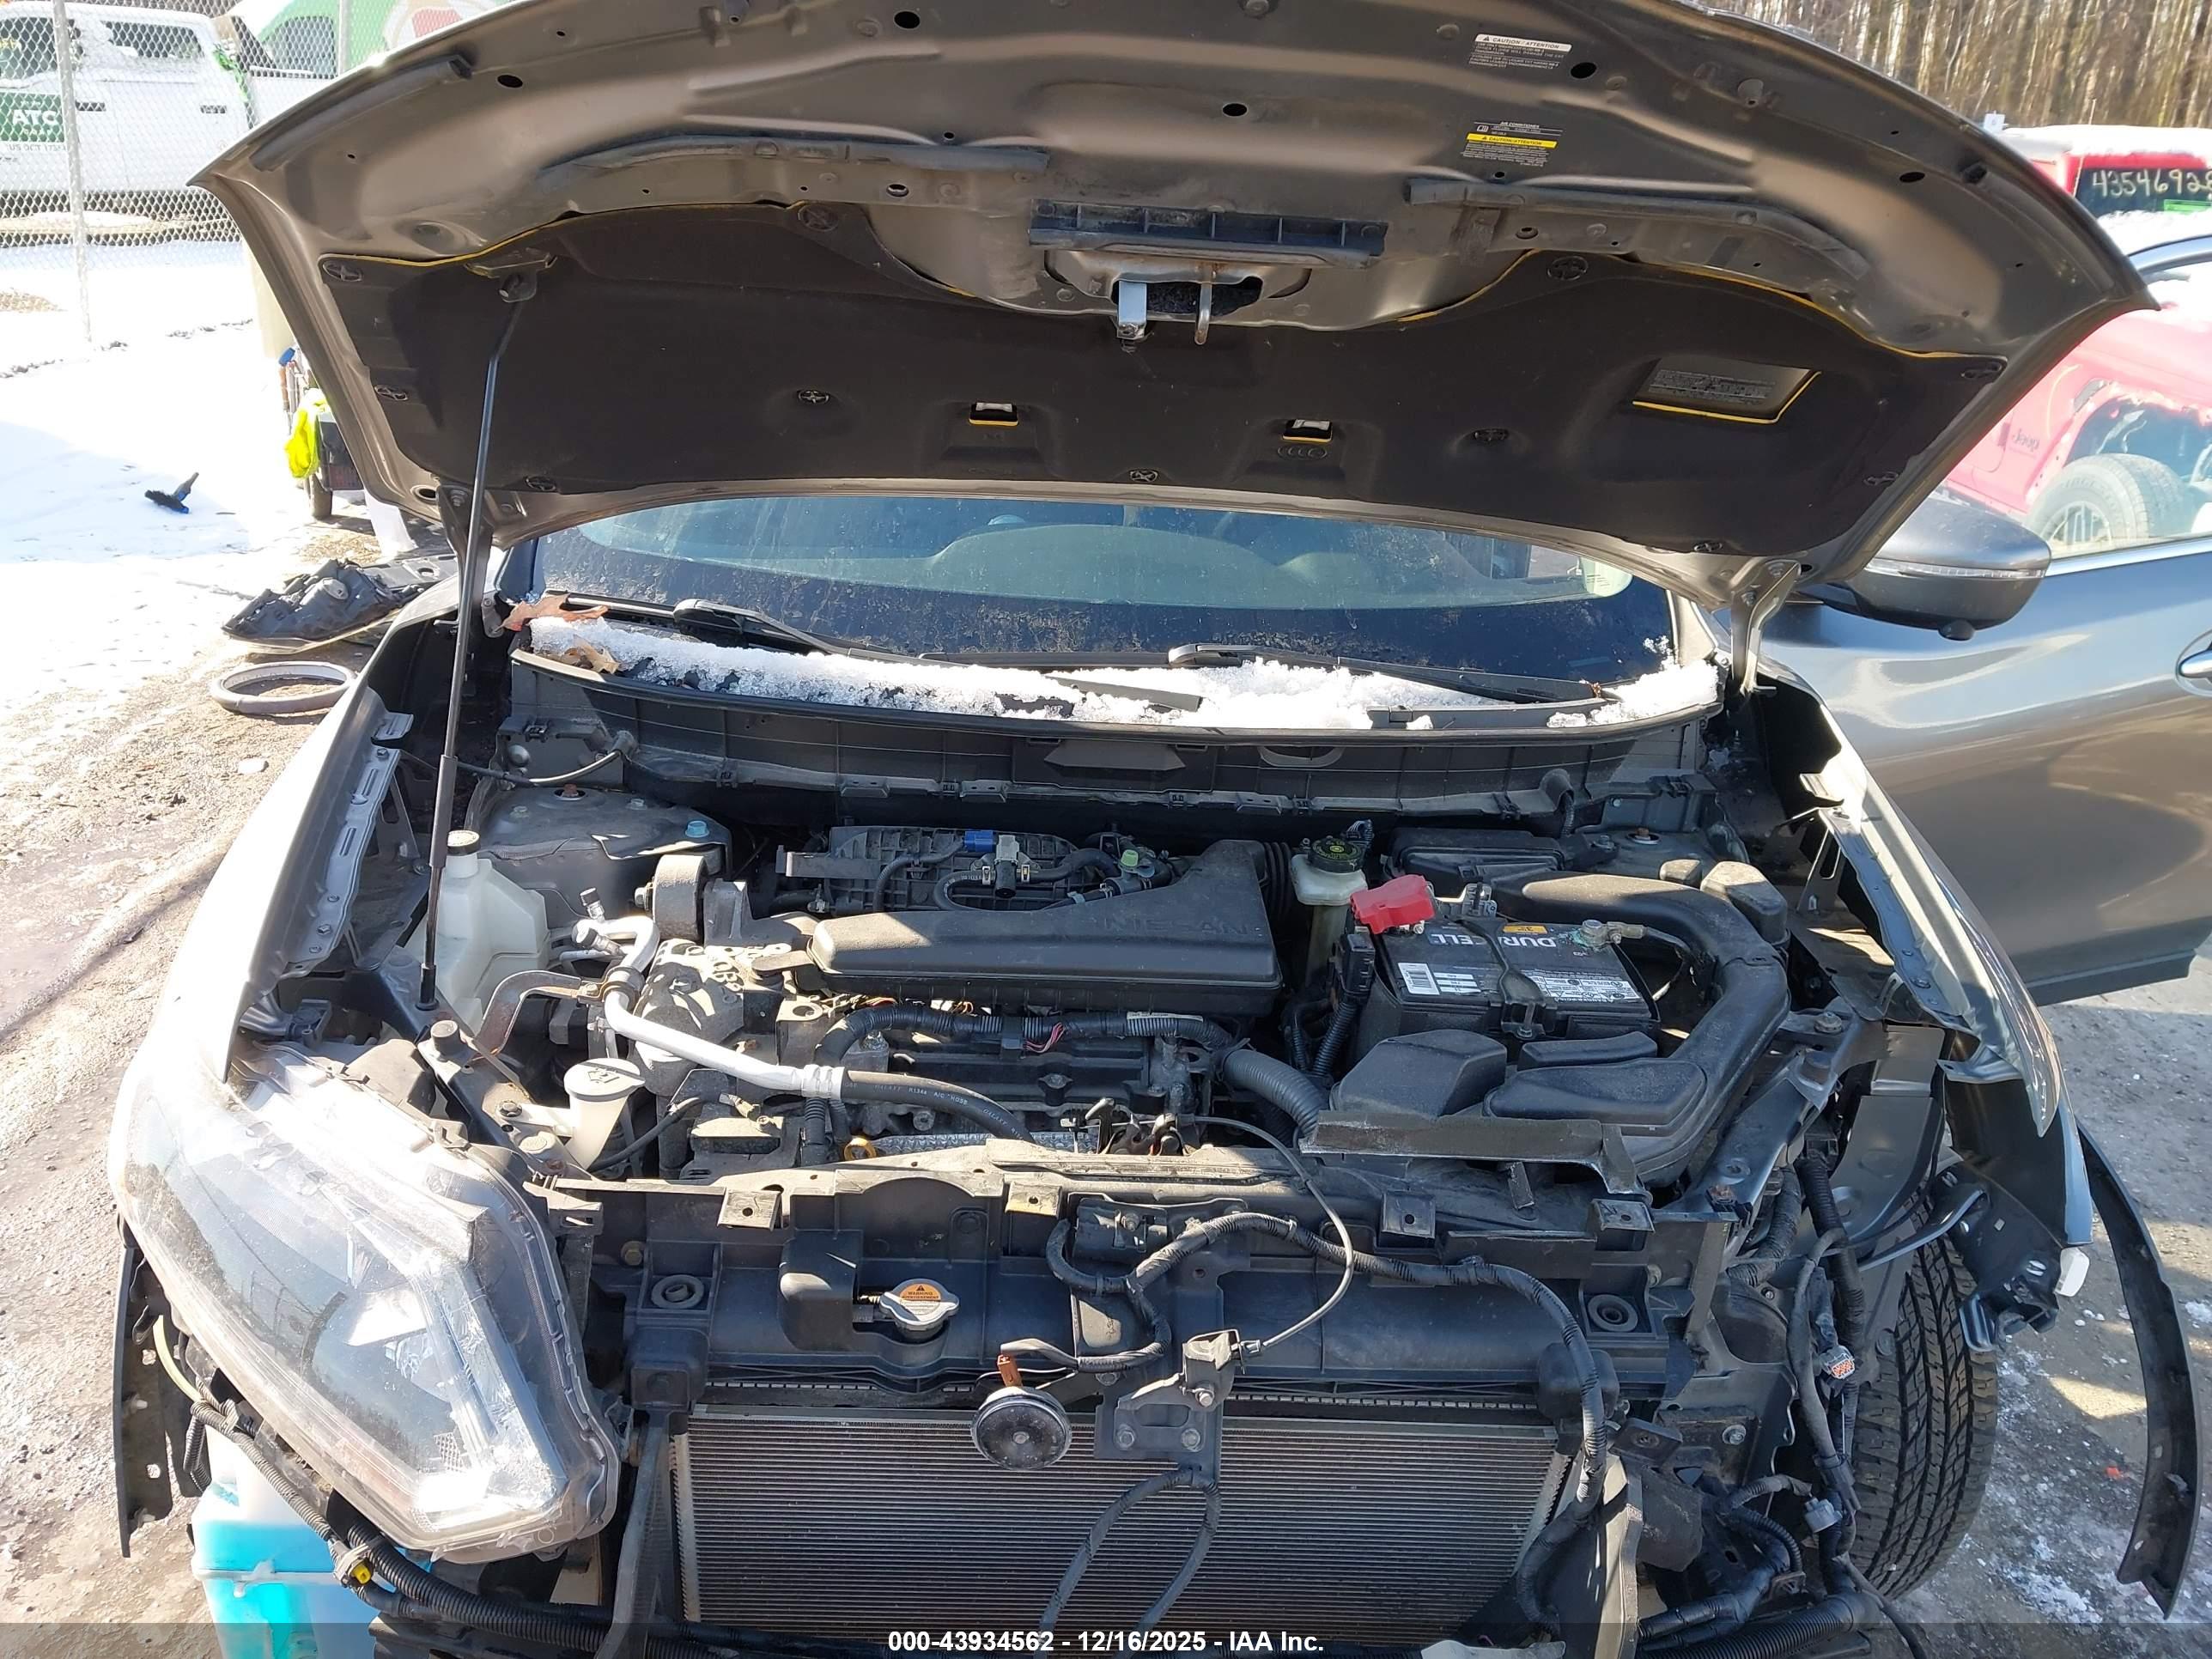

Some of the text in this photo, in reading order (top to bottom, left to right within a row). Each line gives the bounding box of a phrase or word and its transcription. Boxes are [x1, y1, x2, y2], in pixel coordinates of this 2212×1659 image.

[1492, 36, 1521, 45] CAUTION
[1526, 40, 1560, 49] ATTENTION
[12, 109, 58, 125] ATC
